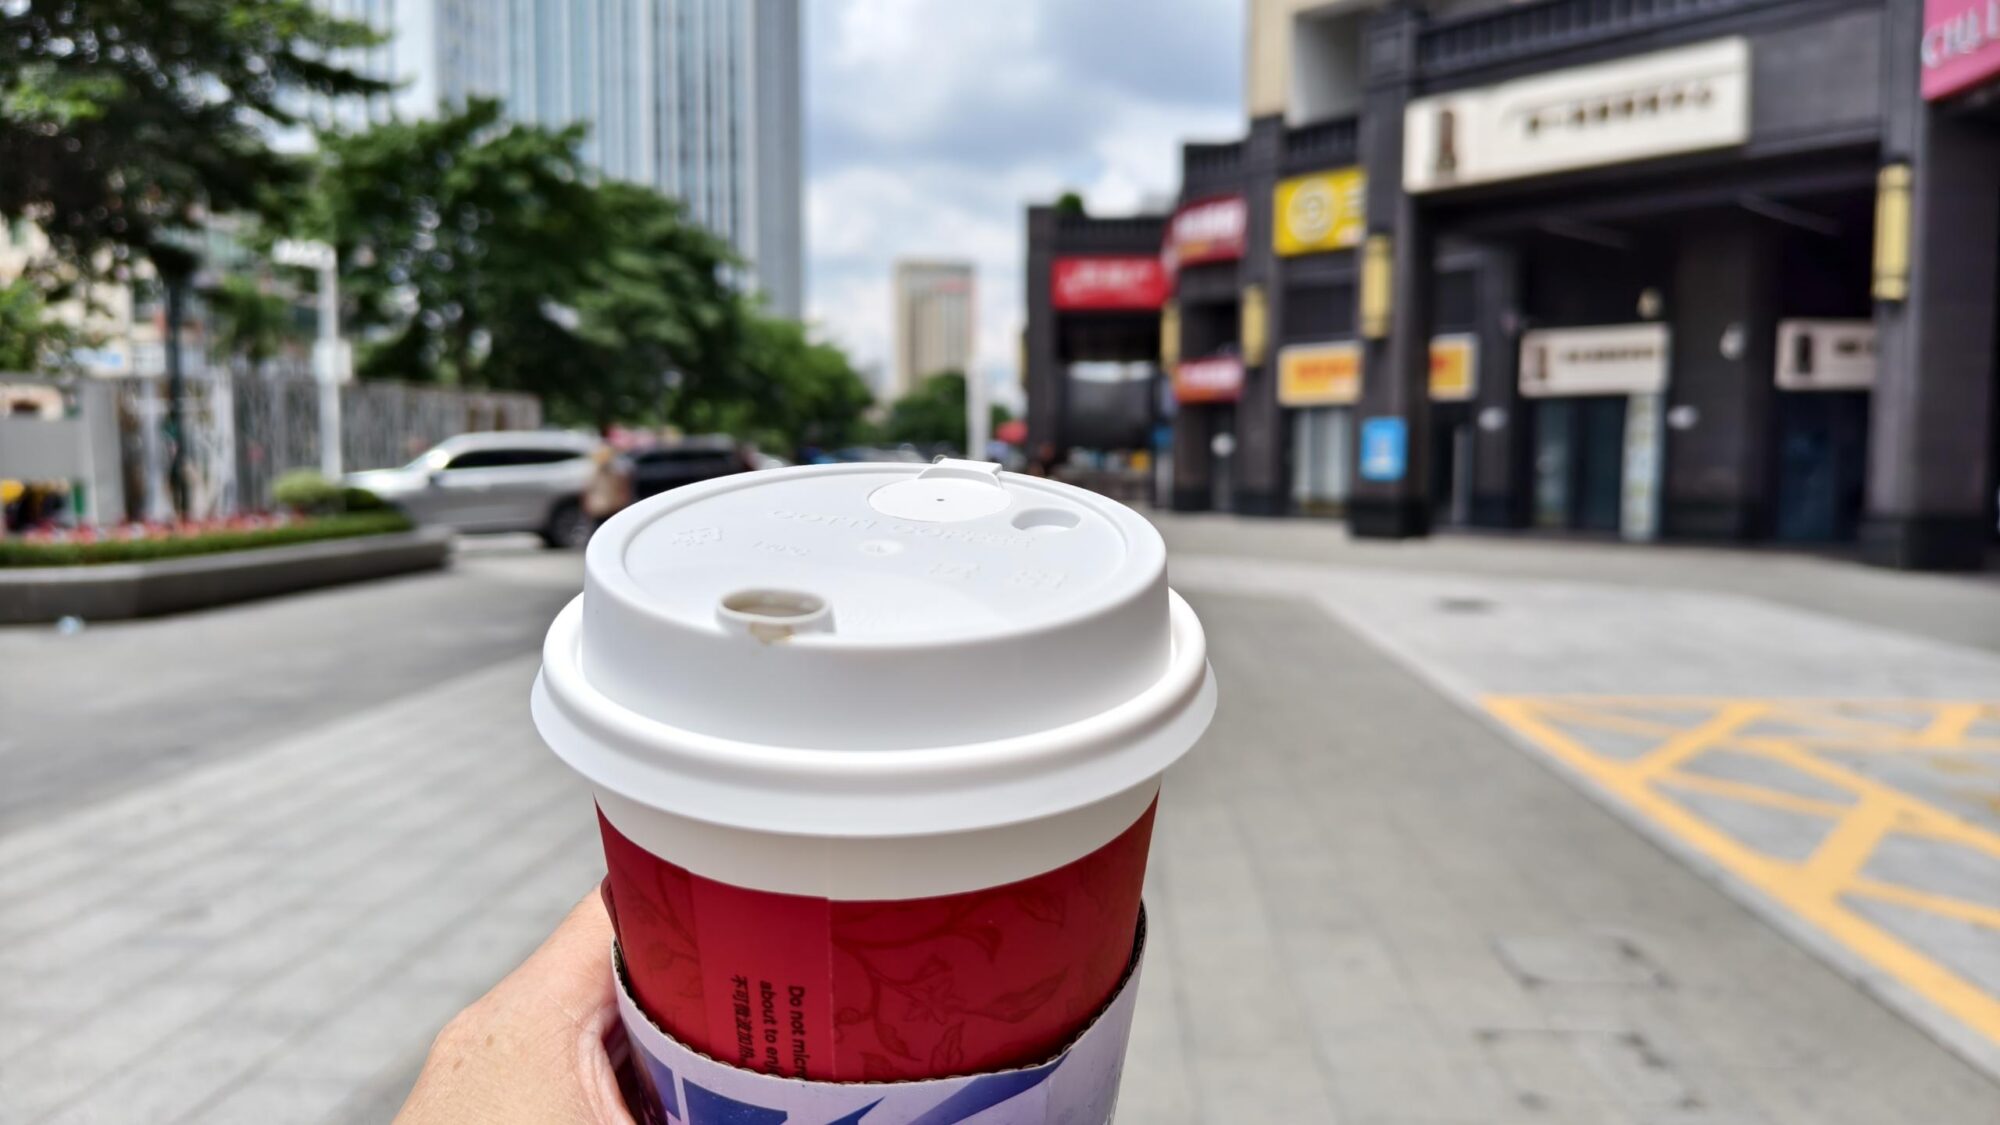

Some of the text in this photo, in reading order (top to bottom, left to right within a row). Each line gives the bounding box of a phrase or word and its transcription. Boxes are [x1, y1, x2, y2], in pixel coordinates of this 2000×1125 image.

[760, 980, 777, 1025] about
[787, 985, 805, 1007] Do
[790, 1010, 806, 1035] not
[764, 1029, 778, 1043] to
